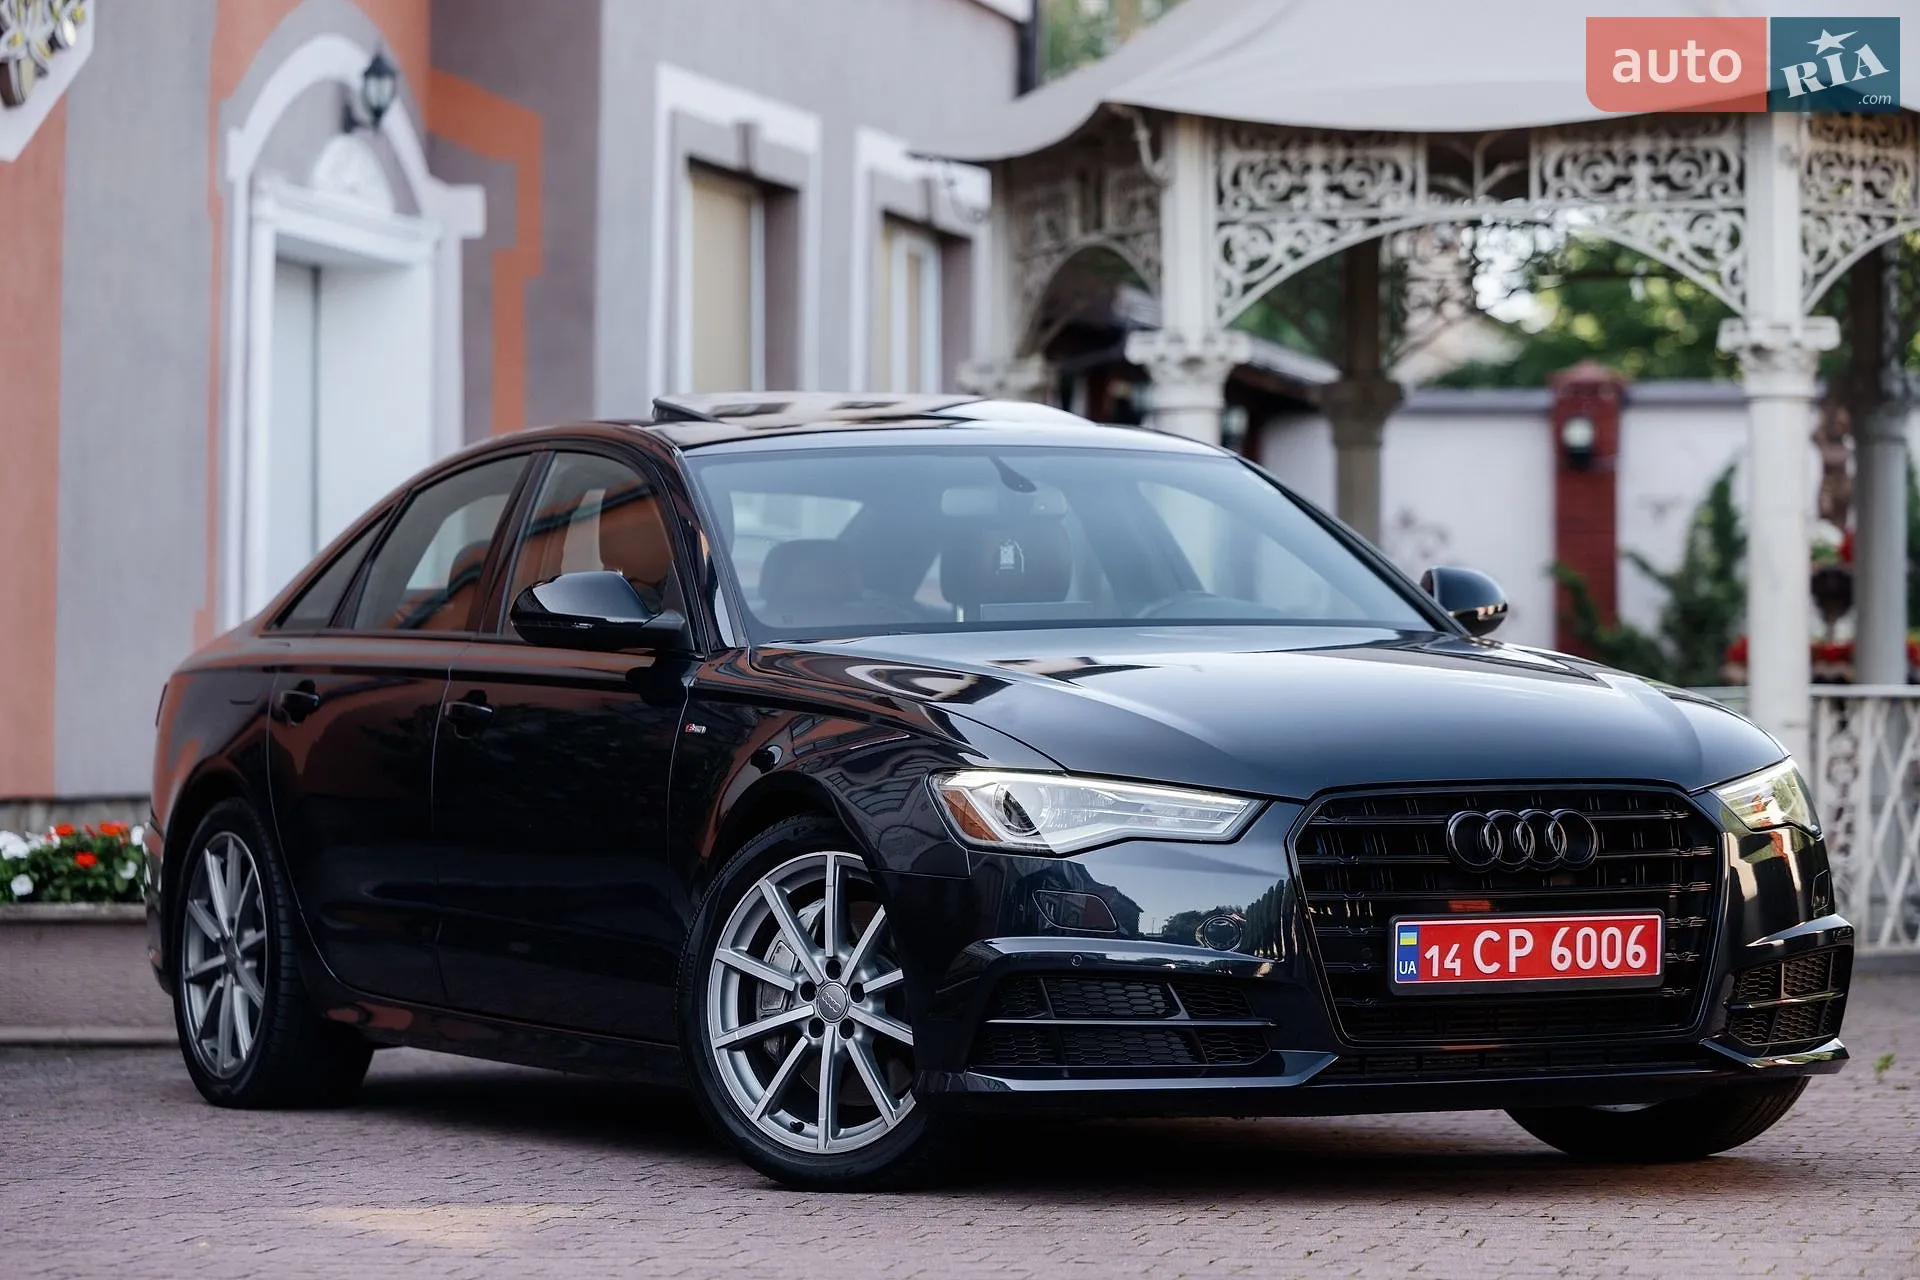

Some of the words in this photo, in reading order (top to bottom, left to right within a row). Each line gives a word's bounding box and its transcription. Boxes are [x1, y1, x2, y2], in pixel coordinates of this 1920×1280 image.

[1399, 960, 1417, 975] UA
[1424, 943, 1461, 978] 14
[1473, 929, 1534, 974] CP
[1550, 925, 1647, 972] 6006
